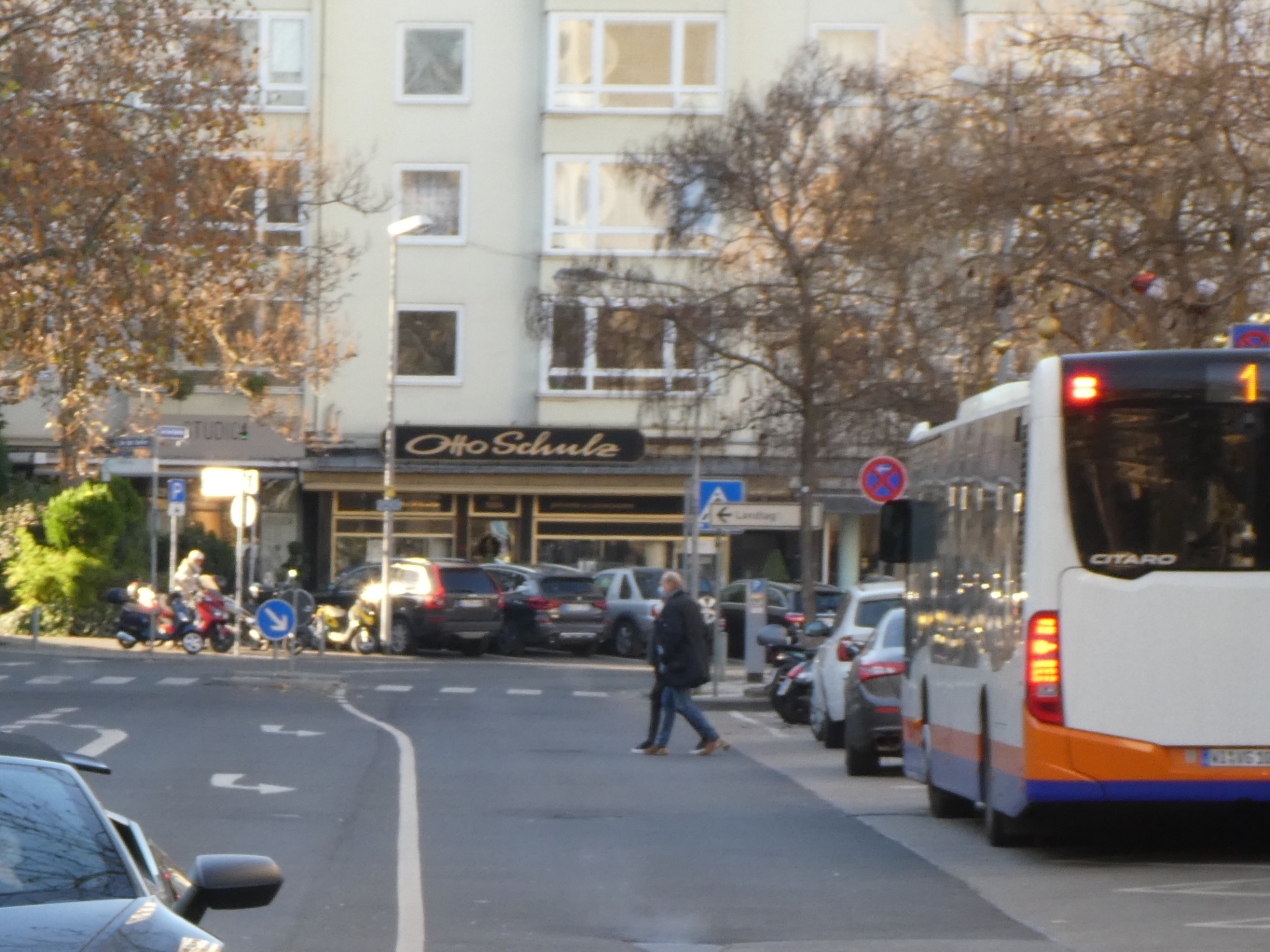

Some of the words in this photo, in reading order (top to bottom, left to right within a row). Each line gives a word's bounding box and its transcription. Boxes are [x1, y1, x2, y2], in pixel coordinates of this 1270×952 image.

[1239, 363, 1257, 402] 1
[405, 433, 490, 457] Otto
[492, 430, 622, 458] Schulz
[1089, 553, 1178, 565] CITARO
